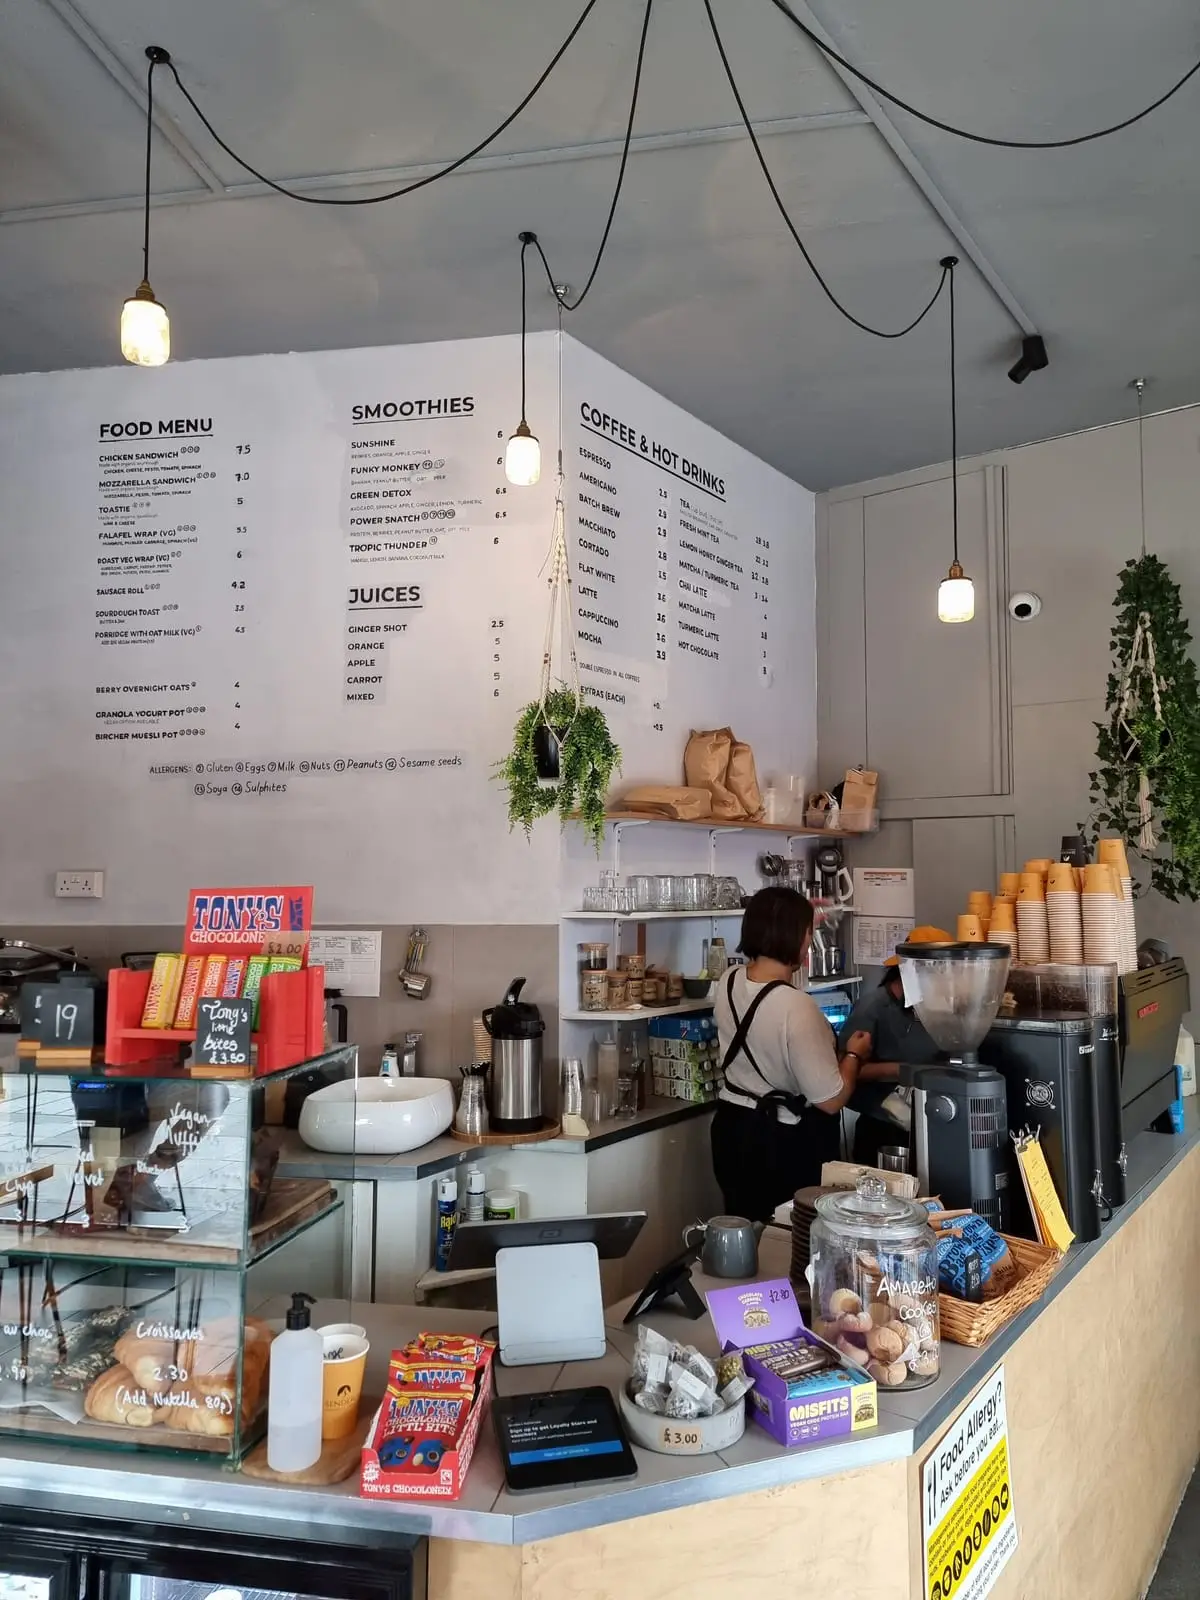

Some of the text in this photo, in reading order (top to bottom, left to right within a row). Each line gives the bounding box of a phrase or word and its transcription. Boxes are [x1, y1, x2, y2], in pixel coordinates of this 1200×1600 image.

[352, 397, 474, 420] SMOOTHIES
[100, 418, 212, 437] FOOD MENU
[351, 439, 395, 448] SUNSHINE
[580, 402, 725, 495] COFFEE & HOT DRINKS
[99, 452, 179, 462] CHICKEN SANDWICH
[579, 447, 611, 470] ESPRESSO
[351, 463, 420, 474] FUNKY MONKEY
[99, 479, 150, 488] MOZZARELLA
[153, 477, 195, 485] SANDWICH
[579, 471, 617, 496] AMERICANO
[350, 490, 411, 500] GREEN DETOX
[680, 498, 690, 509] TEA
[579, 493, 620, 518] BATCH BREW
[385, 514, 420, 523] SNATCH
[99, 531, 132, 539] FALAFEL
[160, 529, 176, 537] (VG)
[579, 517, 616, 539] MACCHIATO
[680, 520, 719, 544] FRESH MINT TEA
[349, 541, 427, 552] TROPIC THUNDER
[579, 538, 610, 558] CORTADO
[680, 540, 697, 553] LEMON
[699, 548, 715, 562] HONEY
[734, 564, 743, 574] TEA
[579, 563, 615, 583] FLAT WHITE
[679, 560, 700, 575] MATCHA
[730, 582, 739, 591] TEA
[97, 588, 126, 596] SAUSAGE
[349, 586, 420, 604] JUICES
[579, 586, 598, 599] LATTE
[679, 580, 707, 598] CHAI LATTE
[96, 610, 137, 618] SOURDOUGH
[578, 608, 619, 629] CAPPUCCINO
[679, 601, 716, 621] MATCHA LATTE
[349, 624, 407, 633] GINGER SHOT
[678, 621, 720, 642] TURMERIC LATTE
[348, 642, 385, 650] ORANGE
[578, 631, 602, 645] MOCHA
[678, 641, 719, 660] HOT CHOCOLATE
[348, 659, 375, 667] APPLE
[123, 685, 167, 693] OVERNIGHT
[347, 676, 383, 684] CARROT
[347, 693, 374, 701] MIXED
[580, 685, 625, 704] EXTRAS (EACH)
[150, 756, 462, 774] ALLERGENS: Gluten Eggs Milk Nuts Peanuts Sesame seeds
[206, 781, 287, 796] Soya Sulphites
[193, 895, 284, 932] TONY'S
[190, 931, 265, 944] CHOCOLONE
[55, 1004, 78, 1041] 19
[202, 1000, 248, 1029] Tony's
[204, 1036, 238, 1052] bites
[5, 1179, 34, 1198] Chip
[136, 1322, 205, 1341] Croissants
[152, 1367, 188, 1382] 2.30
[115, 1385, 147, 1413] (Add
[790, 1396, 849, 1422] MISFITS
[425, 1423, 456, 1436] BITS
[940, 1380, 1002, 1480] Food Allergy?
[940, 1480, 953, 1508] Ask
[954, 1451, 975, 1486] before
[975, 1437, 988, 1462] you
